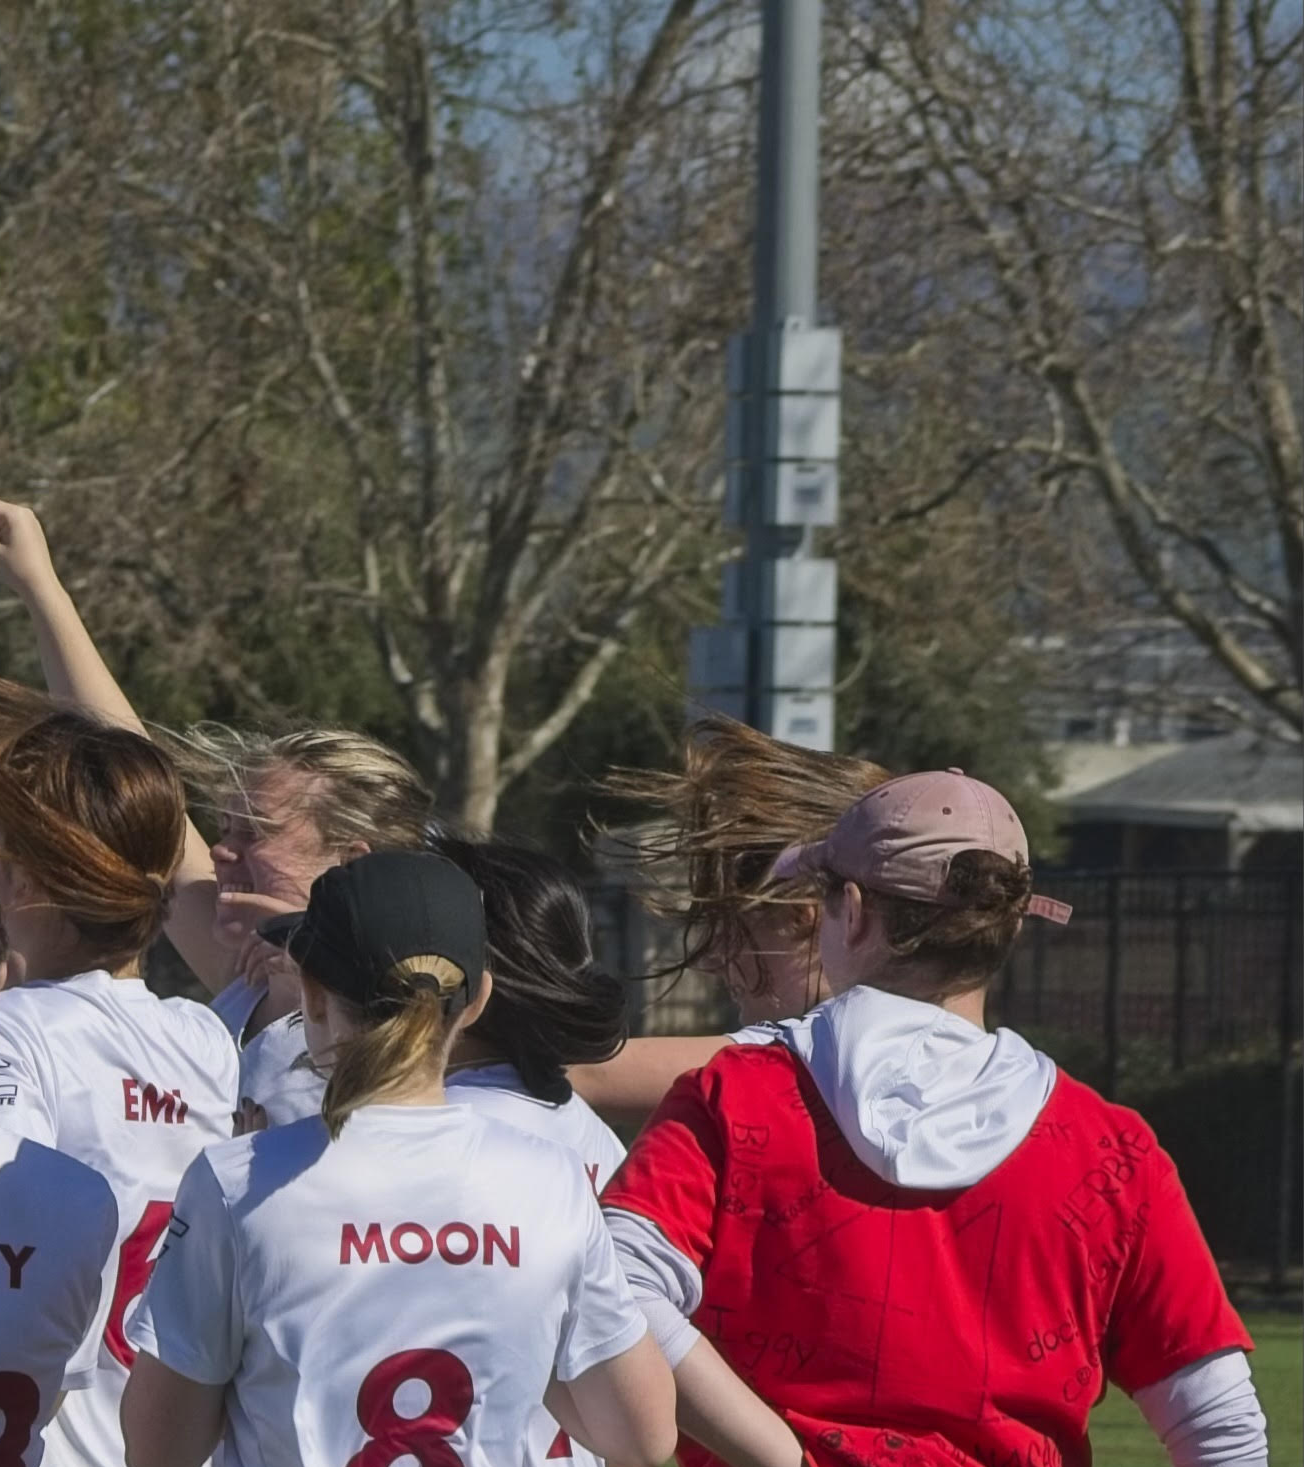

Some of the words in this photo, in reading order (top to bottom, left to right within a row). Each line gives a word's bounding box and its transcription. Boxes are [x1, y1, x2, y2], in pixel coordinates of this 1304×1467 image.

[122, 1078, 189, 1124] EMI
[731, 1123, 770, 1193] BUG
[1054, 1129, 1152, 1243] HERBIE
[339, 1221, 521, 1268] MOON
